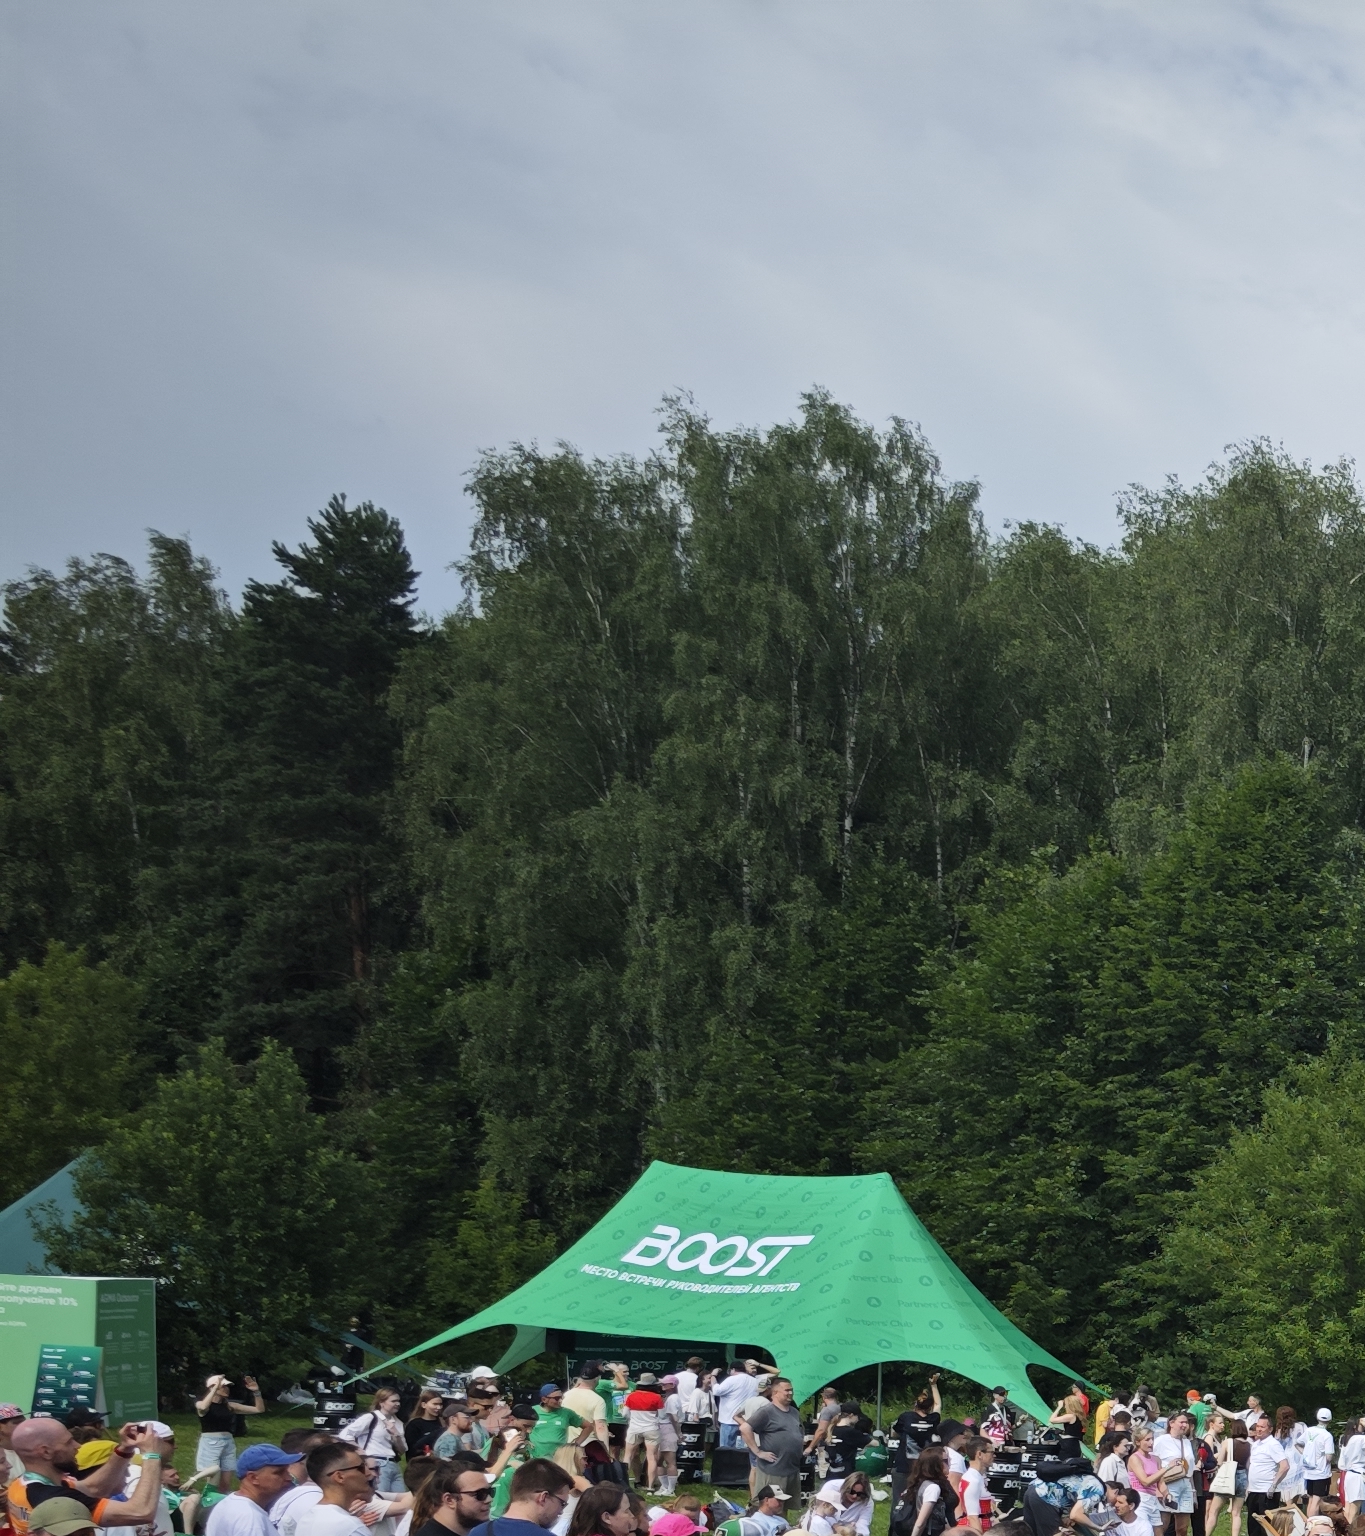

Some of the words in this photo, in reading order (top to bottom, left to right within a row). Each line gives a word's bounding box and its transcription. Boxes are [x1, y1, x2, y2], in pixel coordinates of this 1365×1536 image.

[620, 1224, 816, 1277] BOOST
[580, 1263, 618, 1280] МЕСТО
[618, 1271, 667, 1288] ВСТРЕЧИ
[666, 1280, 753, 1294] РУКОВОДИТЕЛЕЙ
[58, 1296, 78, 1307] 10%
[630, 1360, 669, 1371] BOOST
